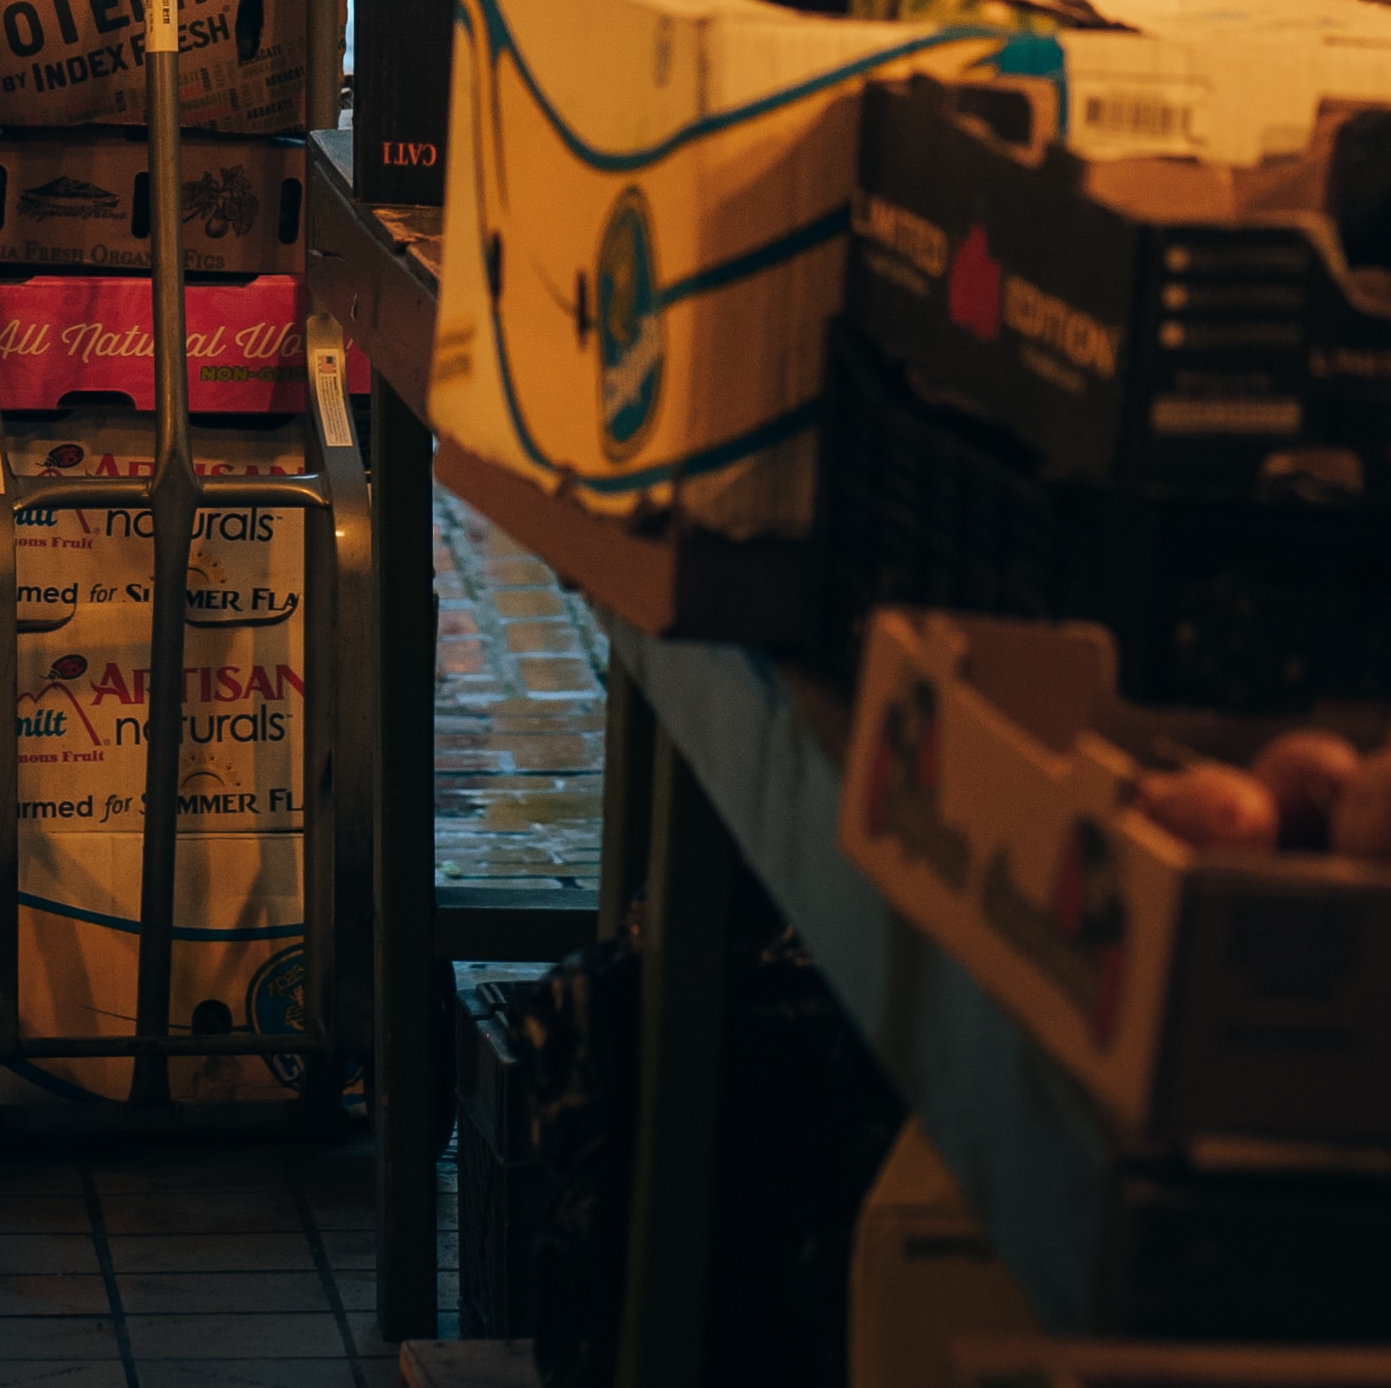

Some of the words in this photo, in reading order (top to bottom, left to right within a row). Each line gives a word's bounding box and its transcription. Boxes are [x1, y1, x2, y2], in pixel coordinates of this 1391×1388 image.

[2, 71, 27, 93] BY
[33, 40, 129, 94] INDEX
[130, 13, 231, 68] FESH
[24, 240, 84, 262] FRESH
[91, 243, 153, 267] ORGAN
[183, 249, 225, 270] FIGS
[60, 321, 225, 364] Natual
[50, 537, 94, 549] Fruit
[90, 583, 118, 603] for
[251, 587, 301, 612] FLA
[115, 704, 286, 746] nurals
[61, 750, 105, 763] Fruit
[99, 794, 134, 824] for
